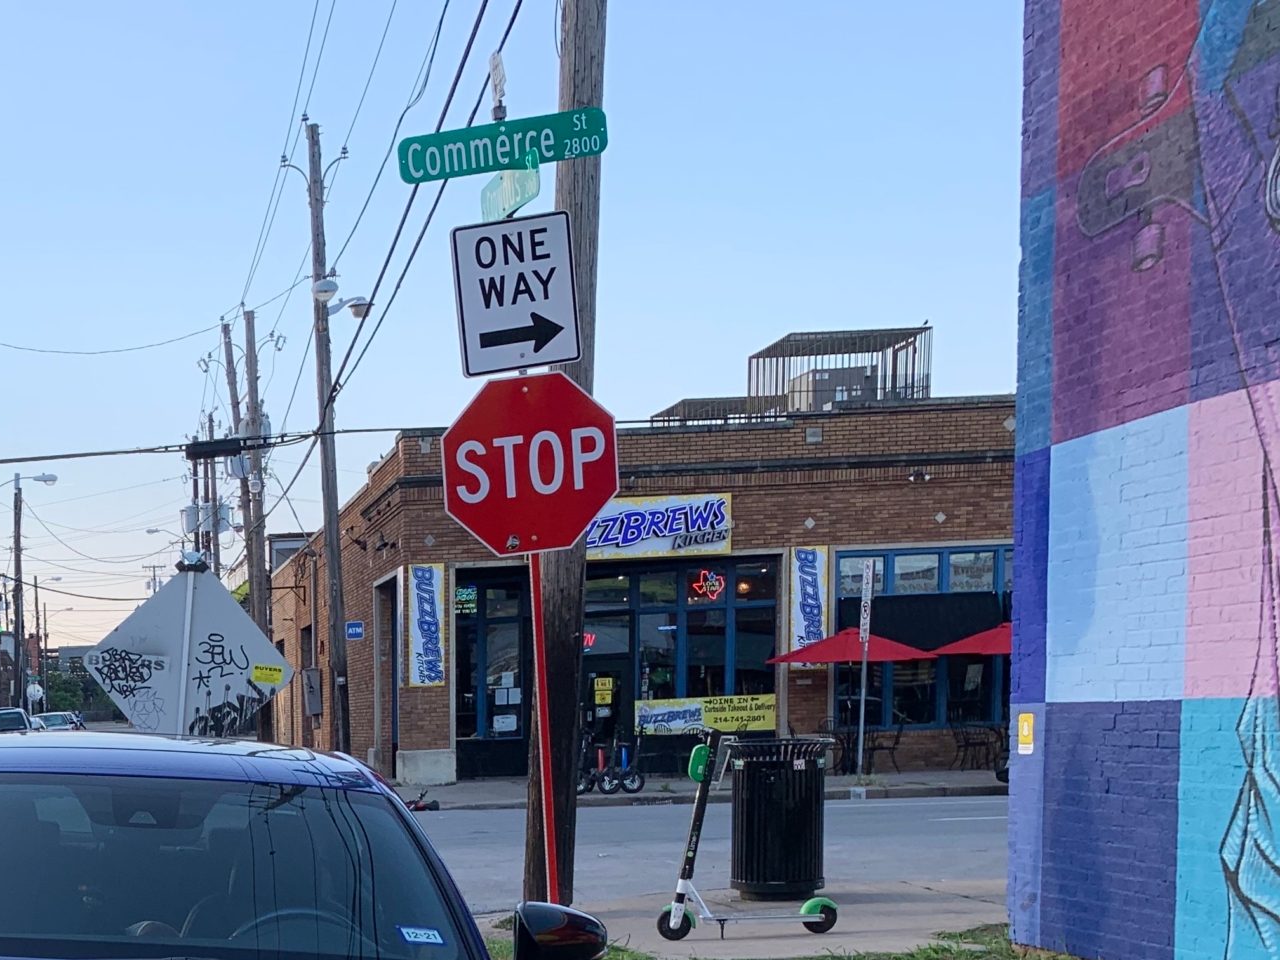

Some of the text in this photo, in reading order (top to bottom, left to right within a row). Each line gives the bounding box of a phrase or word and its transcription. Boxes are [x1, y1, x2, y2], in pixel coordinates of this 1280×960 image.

[407, 113, 588, 179] Commerce St
[563, 135, 601, 157] 2800
[474, 227, 551, 269] ONE
[478, 266, 557, 309] WAY
[456, 426, 606, 504] STOP
[586, 498, 727, 548] ZZBREWS
[672, 529, 729, 549] KITCHEN
[411, 565, 443, 682] BUZZBREWS
